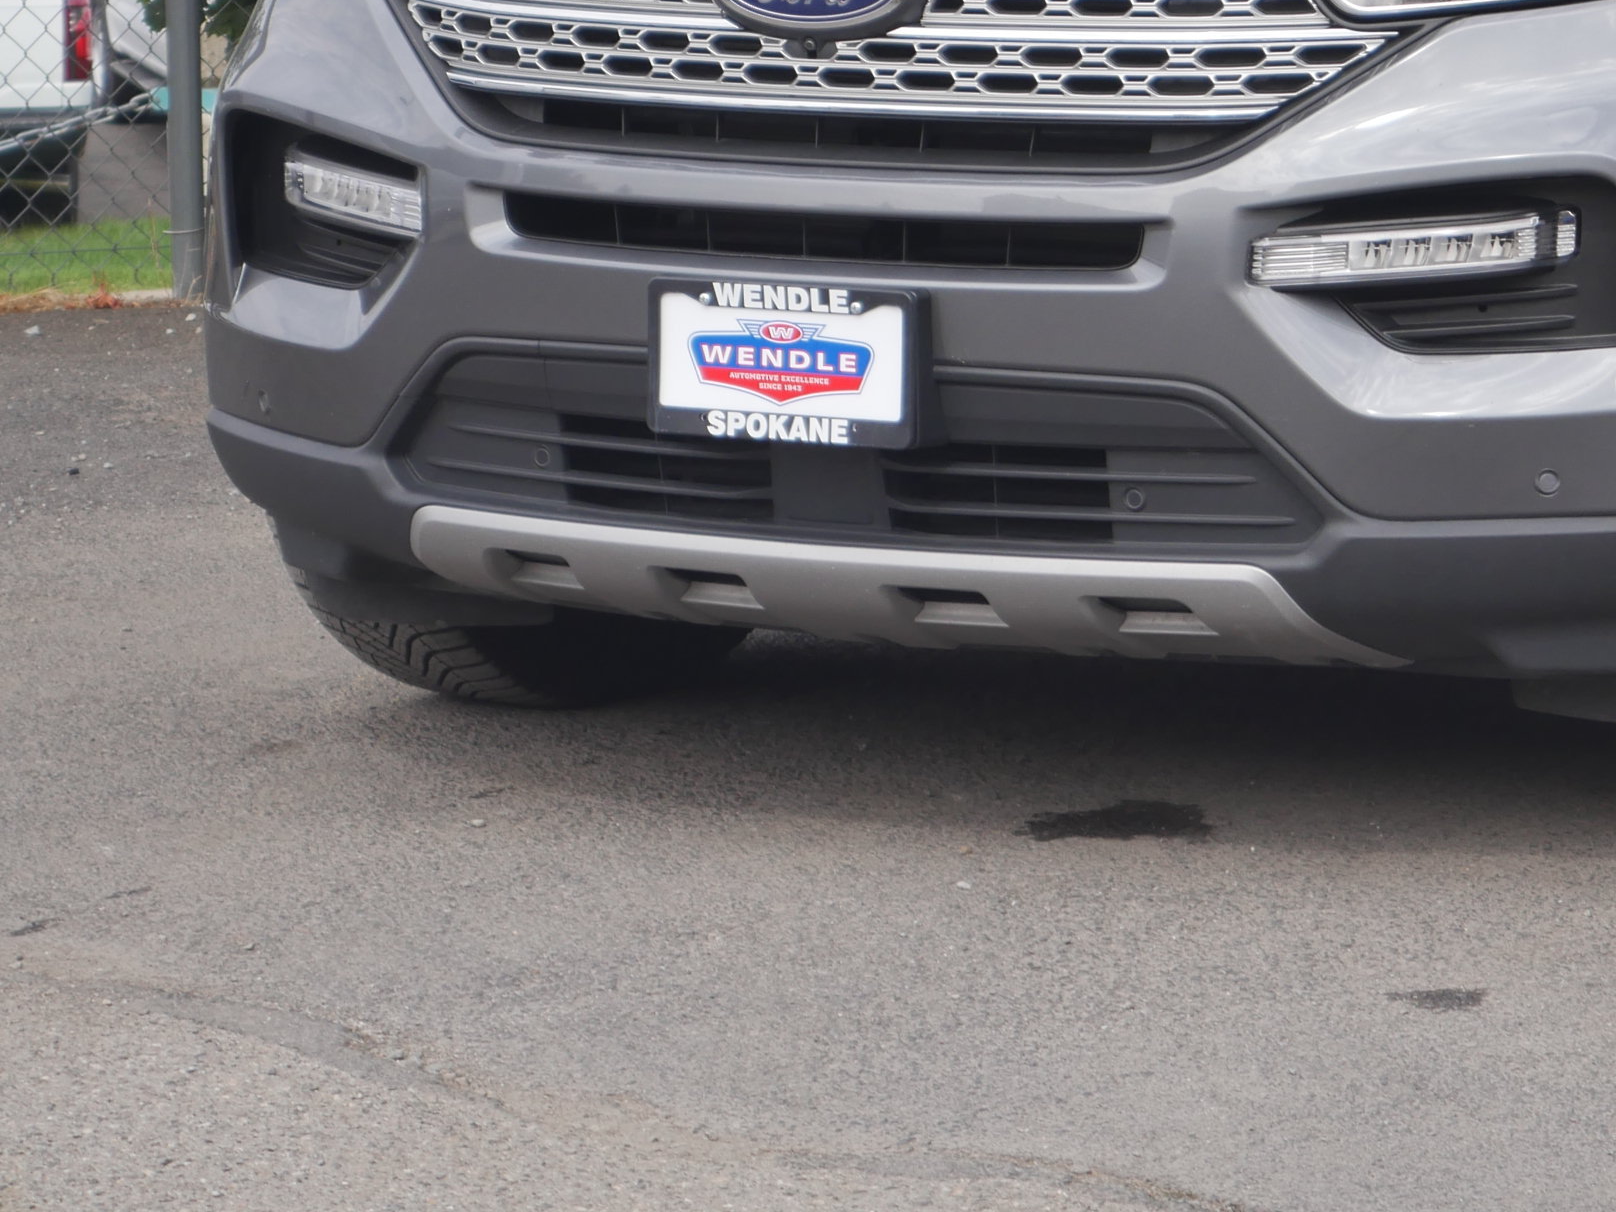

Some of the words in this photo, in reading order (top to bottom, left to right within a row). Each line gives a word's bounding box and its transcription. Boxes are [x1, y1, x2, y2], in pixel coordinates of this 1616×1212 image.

[711, 281, 850, 314] WENDLE
[700, 344, 858, 374] WENDLE
[729, 370, 780, 382] AUTOMOTIVE
[781, 373, 830, 385] EXCELLENCE
[758, 381, 782, 391] SINCE
[706, 409, 850, 445] SPOKANE
